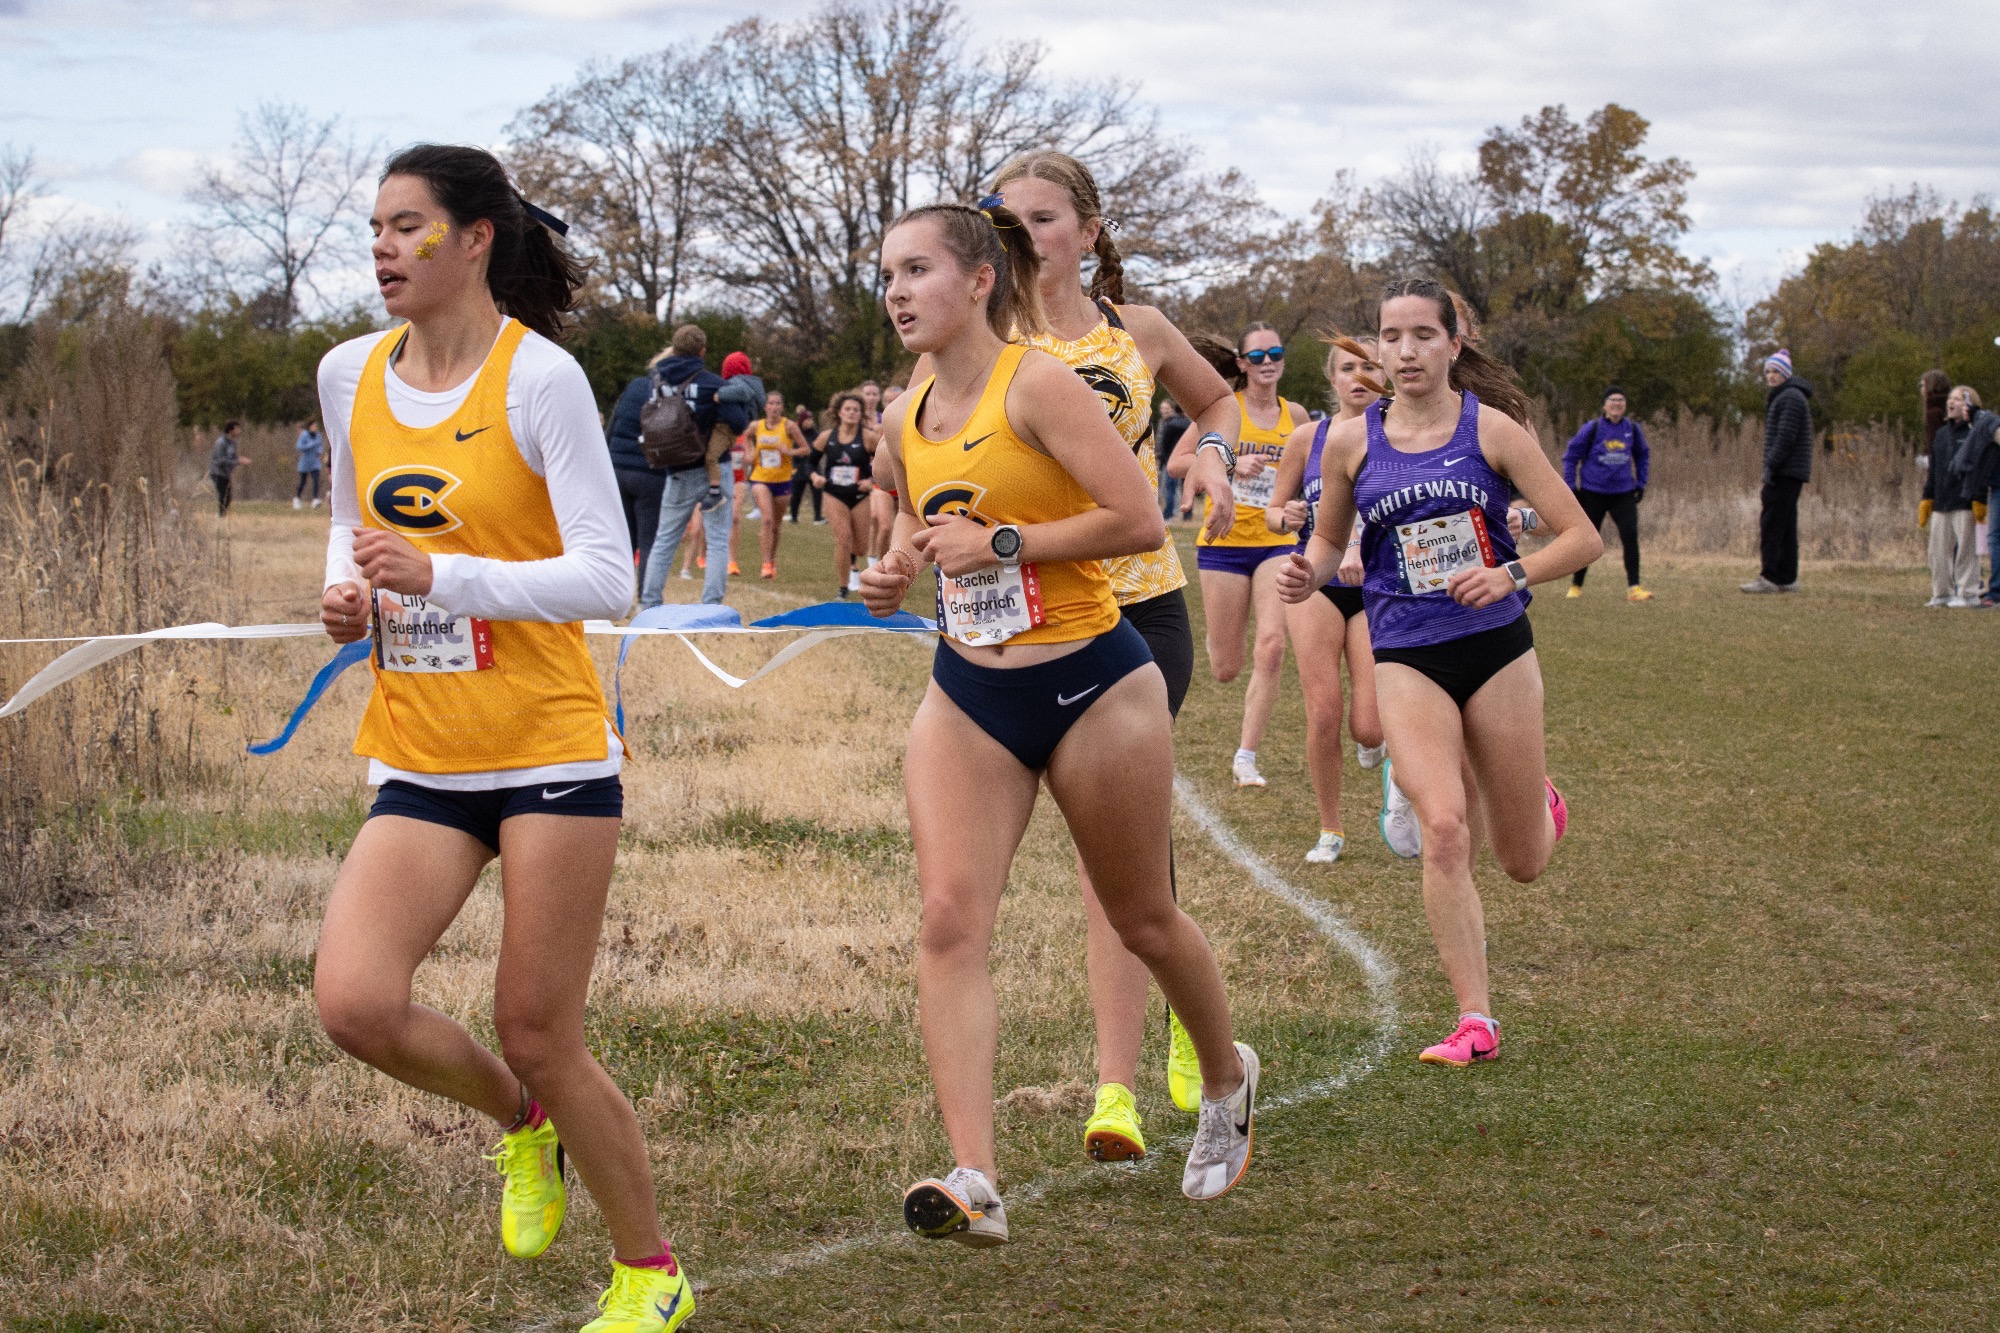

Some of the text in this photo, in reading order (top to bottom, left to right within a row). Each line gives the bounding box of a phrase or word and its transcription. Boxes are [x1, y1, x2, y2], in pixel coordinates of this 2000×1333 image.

[1368, 479, 1488, 524] WHITEWATER
[1418, 534, 1457, 549] Emma
[1407, 542, 1479, 571] Henningfeld
[955, 570, 1000, 589] Rachel
[401, 594, 426, 611] Lily
[950, 594, 1016, 616] Gregorich
[1033, 604, 1041, 624] XC
[388, 619, 456, 635] Guenther
